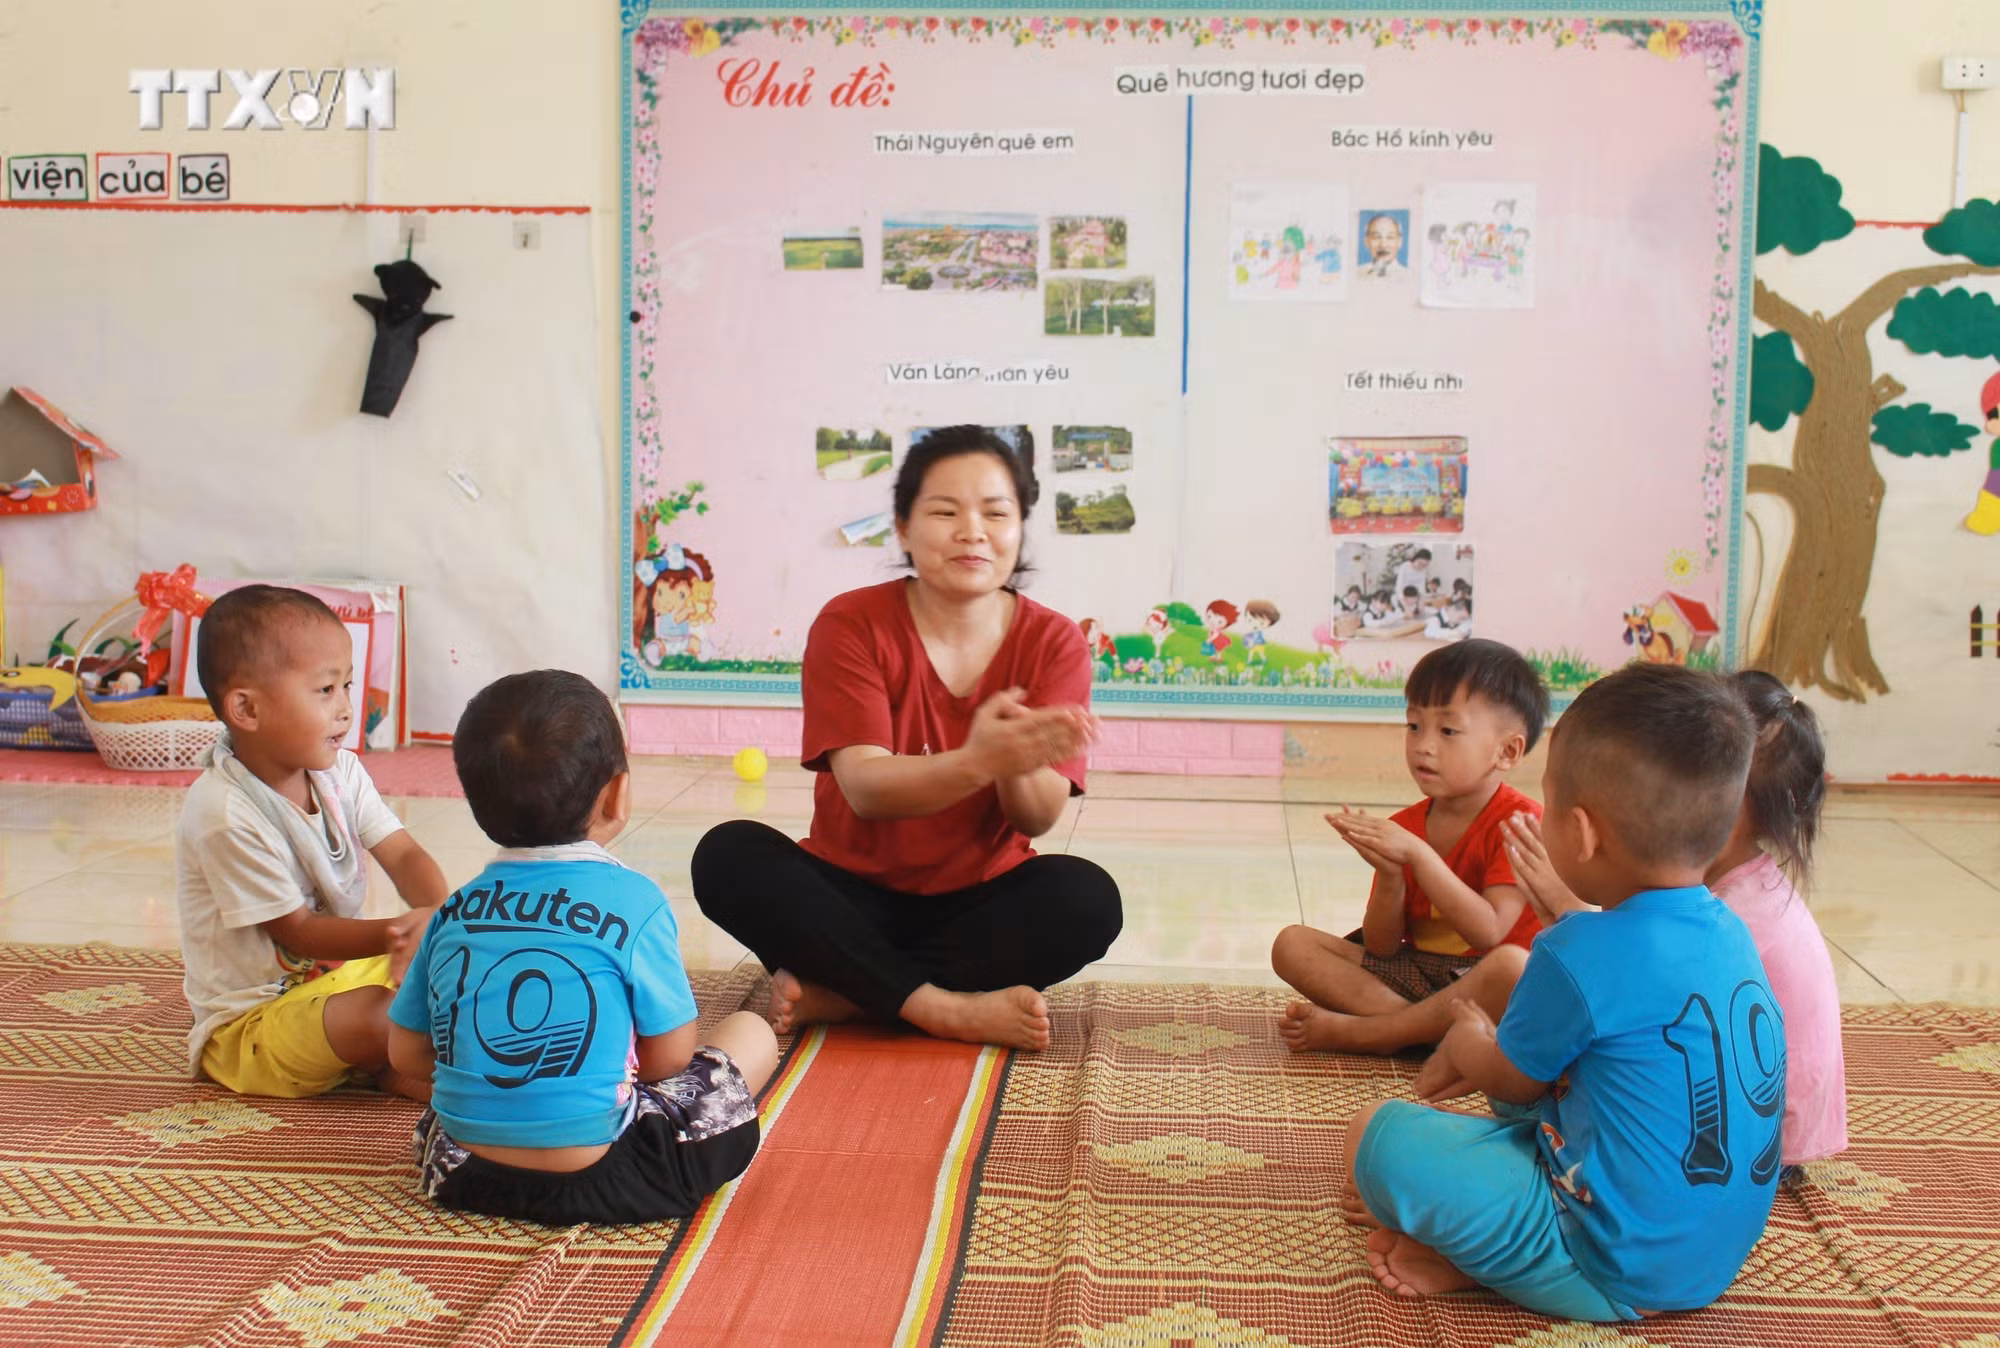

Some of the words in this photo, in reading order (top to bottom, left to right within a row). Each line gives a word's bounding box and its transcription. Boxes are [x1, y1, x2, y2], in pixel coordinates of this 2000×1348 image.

[717, 57, 815, 107] Chủ
[830, 62, 895, 107] đề:
[1116, 72, 1169, 94] Quê
[1176, 68, 1255, 92] hương
[1262, 68, 1307, 90] tươi
[1314, 68, 1365, 94] đẹp
[875, 134, 913, 152] Thái
[918, 132, 994, 154] Nguyên
[998, 132, 1036, 153] quê
[1043, 135, 1074, 149] em
[1331, 128, 1369, 148] Bác
[1409, 129, 1450, 148] kính
[1456, 130, 1493, 150] yêu
[13, 161, 84, 197] viện
[100, 158, 166, 194] của
[181, 162, 226, 194] bé
[1032, 363, 1070, 385] yêu
[1379, 370, 1428, 390] thiếu
[1433, 373, 1463, 390] nhi
[440, 880, 630, 951] Rakuten
[430, 945, 597, 1089] 19
[1662, 979, 1786, 1187] 19
